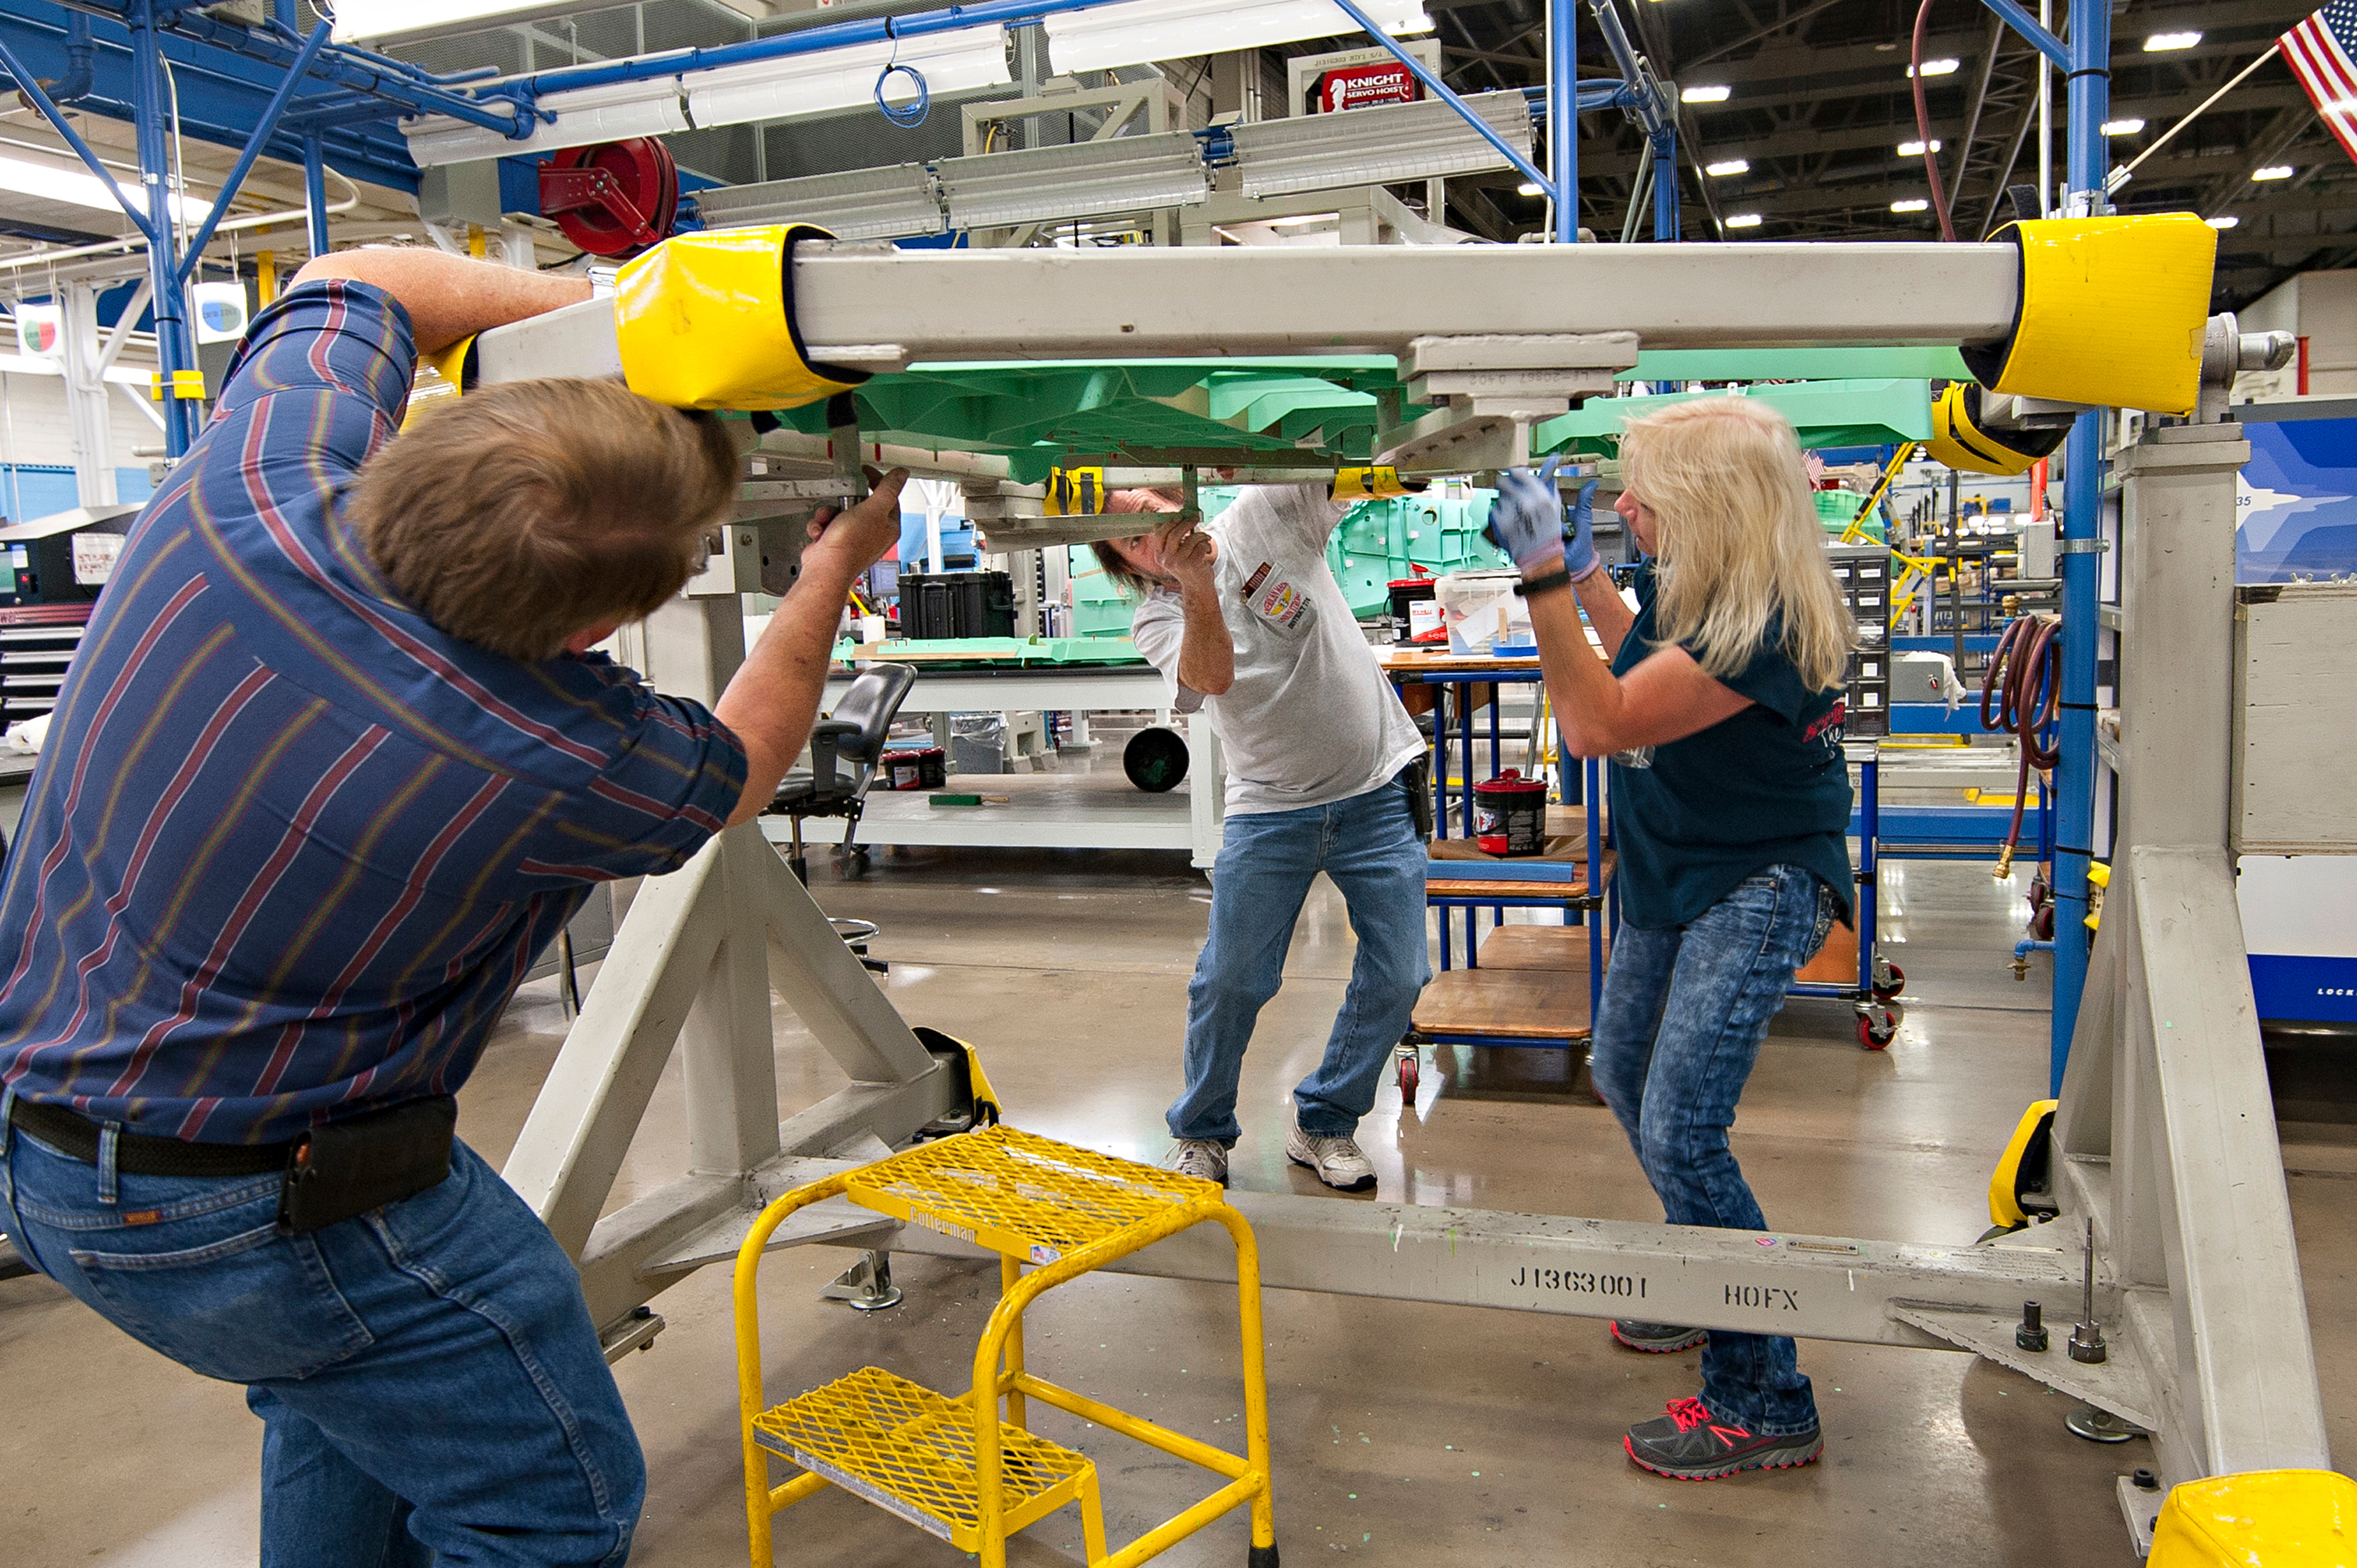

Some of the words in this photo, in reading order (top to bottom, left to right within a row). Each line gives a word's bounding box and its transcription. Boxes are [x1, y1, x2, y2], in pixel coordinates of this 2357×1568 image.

[1347, 73, 1404, 88] KNIGHT
[1347, 88, 1375, 98] SERVO
[1376, 85, 1403, 96] HOIST
[2236, 496, 2251, 506] 35
[2317, 987, 2357, 996] LOCK
[910, 1205, 976, 1243] Cotterman
[1511, 1266, 1647, 1299] J1363001
